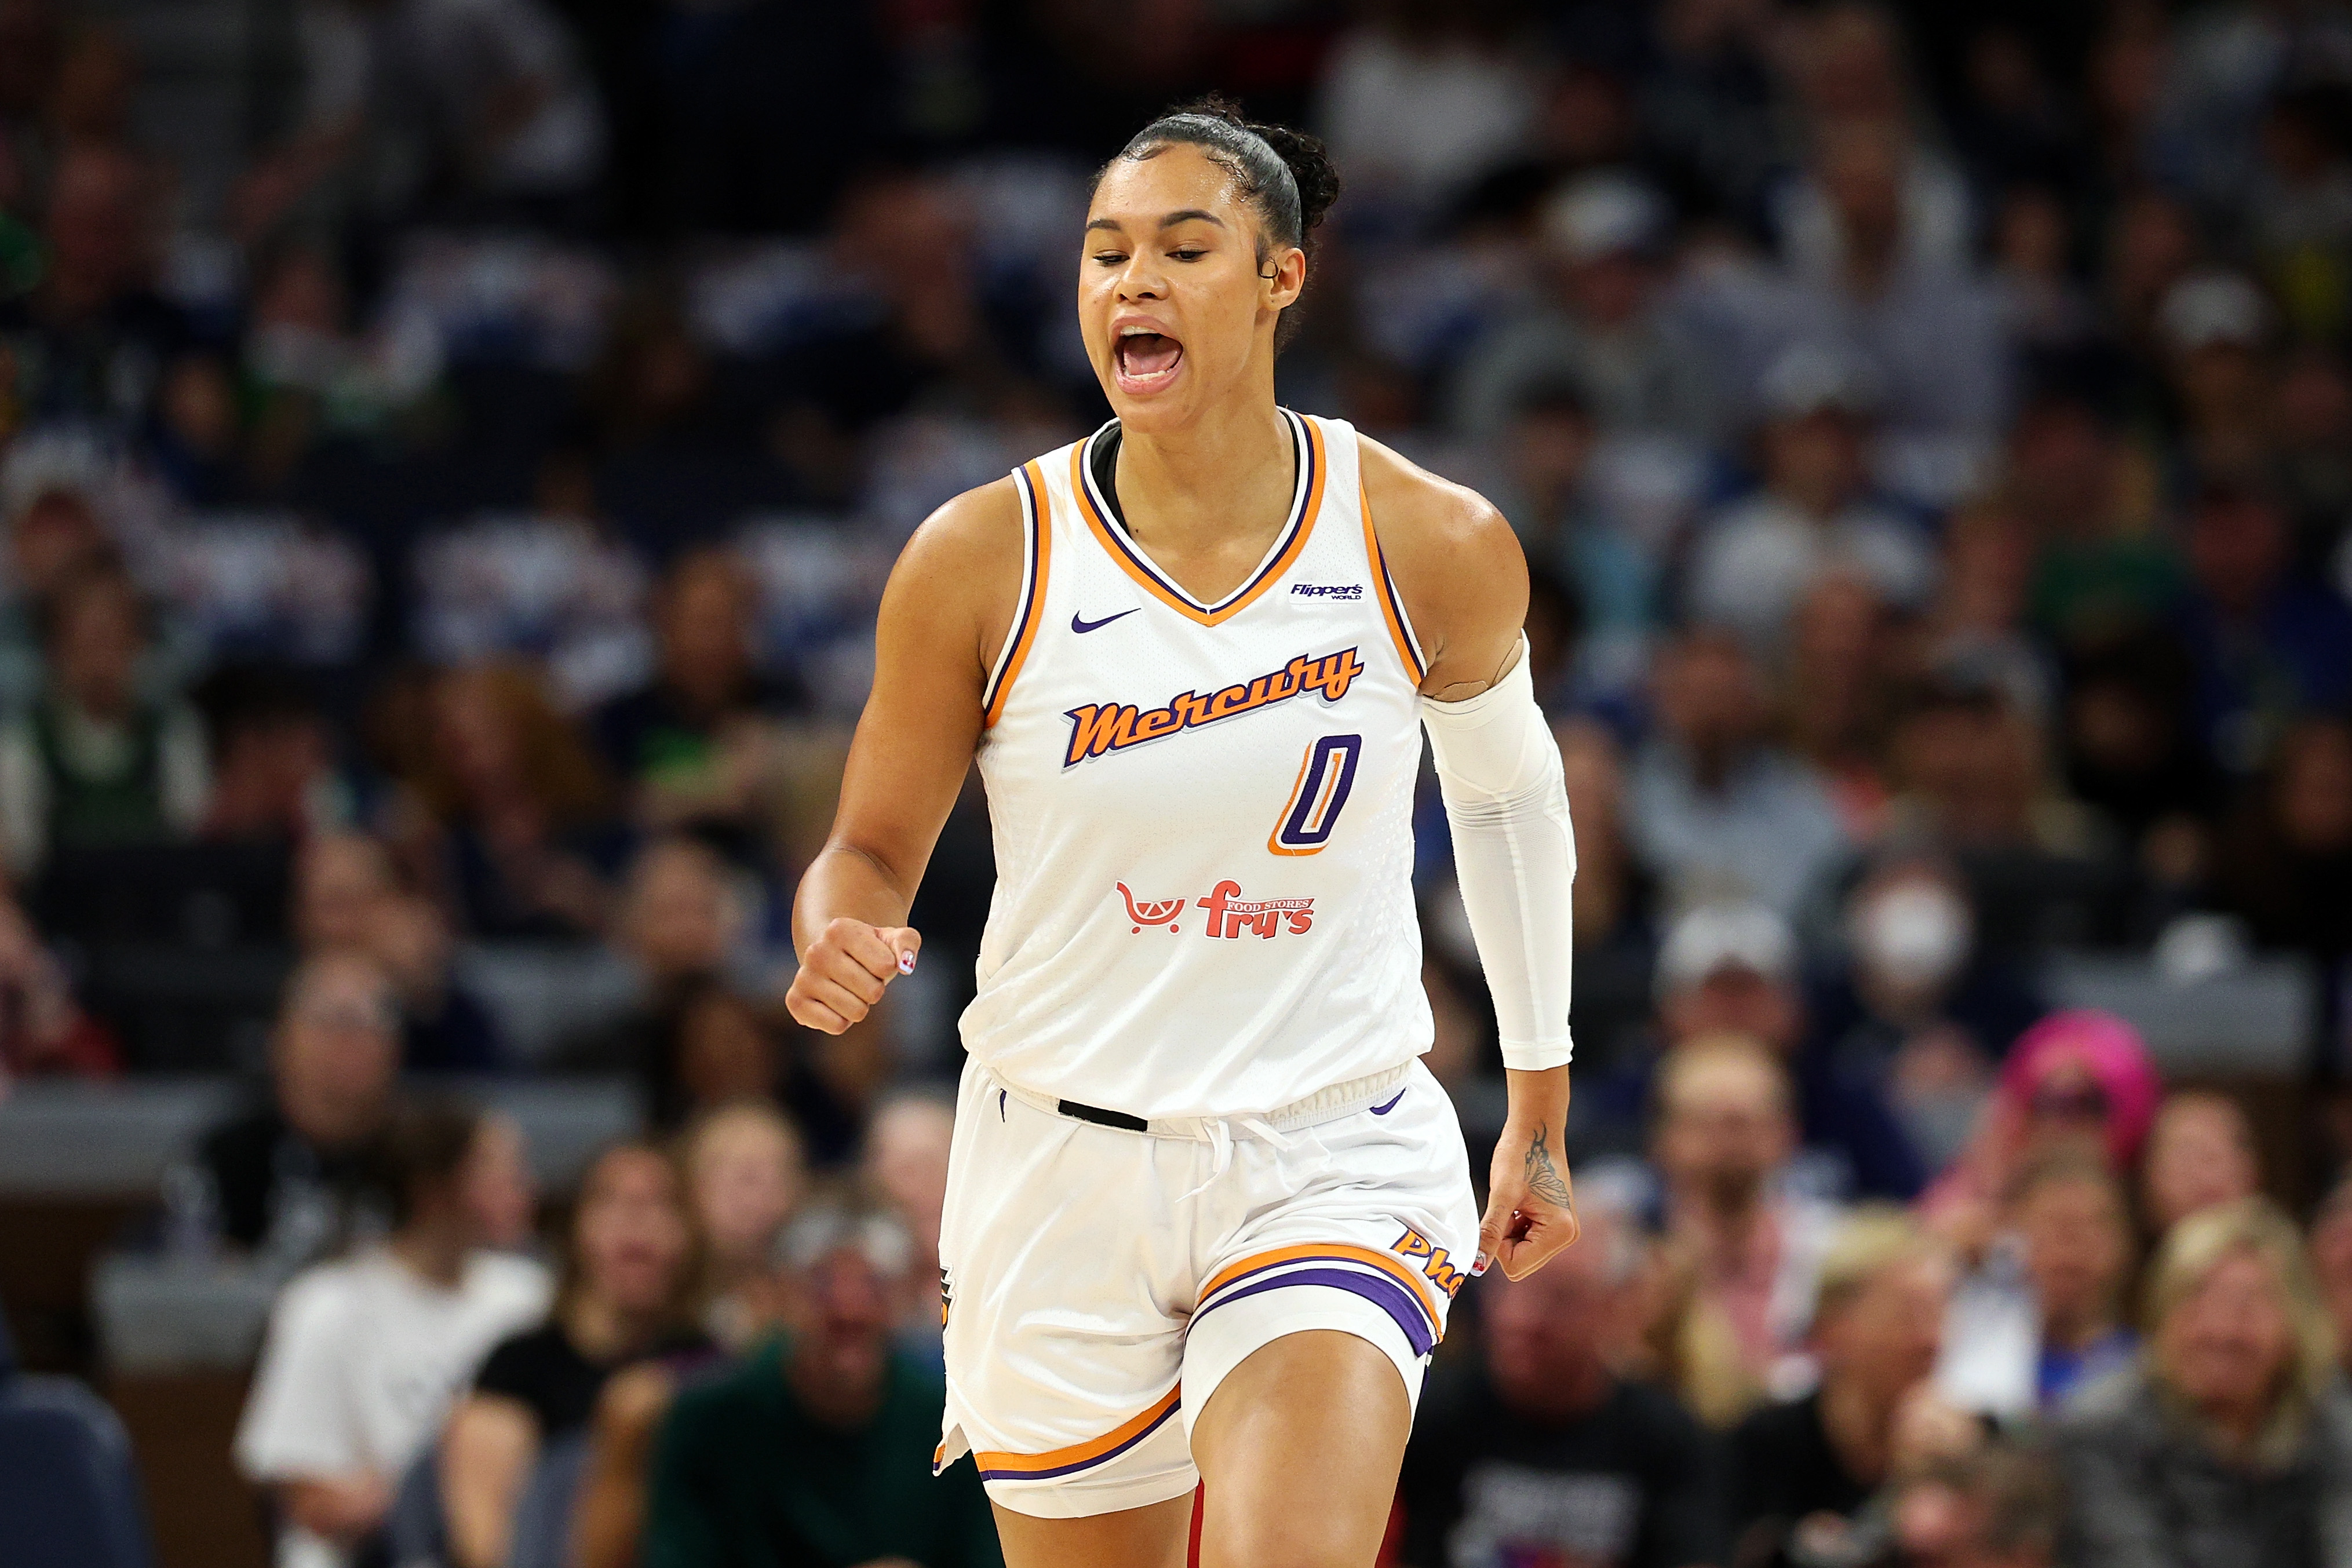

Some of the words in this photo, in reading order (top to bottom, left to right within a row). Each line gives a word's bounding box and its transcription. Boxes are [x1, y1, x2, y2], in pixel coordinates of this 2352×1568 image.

[1290, 584, 1363, 596] Flipper's
[1063, 646, 1364, 771] Mercury
[1267, 734, 1362, 856] 0
[1197, 880, 1314, 939] fry's
[1226, 900, 1261, 911] FOOD
[1264, 899, 1309, 910] STORES
